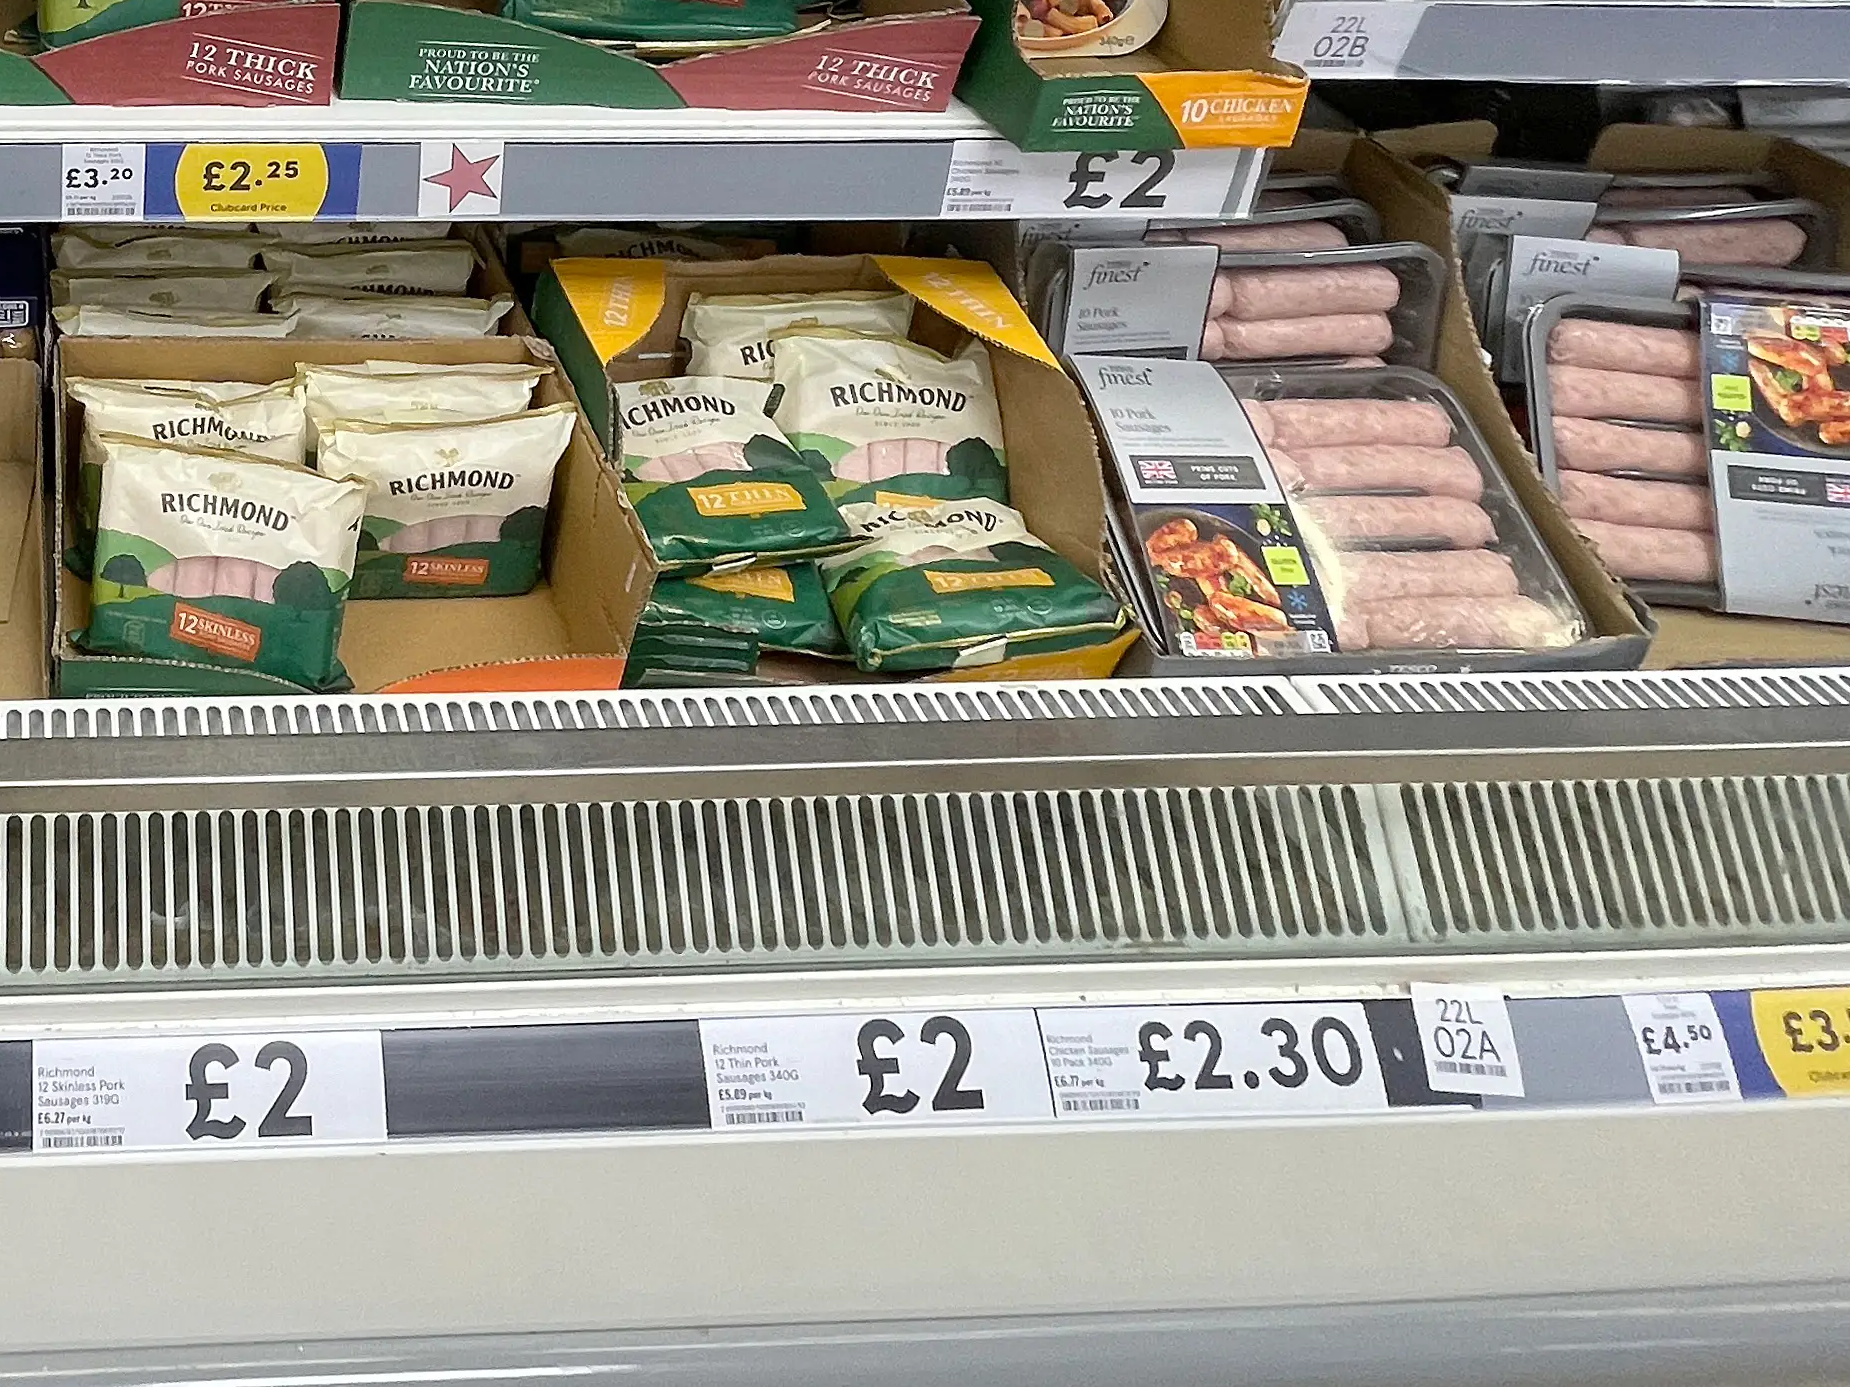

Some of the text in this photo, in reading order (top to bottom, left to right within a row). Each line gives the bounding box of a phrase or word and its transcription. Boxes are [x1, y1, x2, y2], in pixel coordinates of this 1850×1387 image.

[1331, 17, 1365, 33] 22L
[419, 48, 540, 62] PROUD TO BE THE
[1313, 36, 1366, 57] 02B
[190, 43, 318, 80] 12 THICK
[423, 60, 529, 76] NATION'S
[815, 54, 935, 89] 12 THICK
[186, 61, 314, 94] PORK SAUSAGES
[807, 72, 931, 102] PORK SAUSAGES
[1181, 100, 1292, 123] 10 CHICKEN
[66, 167, 133, 189] £3.20
[203, 160, 298, 191] £2.25
[1064, 151, 1175, 208] £2
[210, 203, 287, 212] Clubcard Price
[389, 471, 514, 496] RICHMOND
[697, 487, 789, 509] 12 THIN
[161, 492, 289, 532] RICHMOND
[409, 561, 485, 575] 12 SKINLESS
[178, 613, 256, 647] 12 SKINLESS
[1436, 999, 1482, 1025] 22L
[713, 1043, 768, 1054] Richmond
[1434, 1026, 1501, 1061] 02A
[1641, 1026, 1712, 1055] £4.50
[715, 1056, 779, 1069] 12 Thin Pork
[857, 1016, 984, 1114] £2
[1138, 1016, 1363, 1091] £2.30
[38, 1066, 95, 1078] Richmond
[717, 1070, 799, 1085] Sausages 340G
[38, 1080, 124, 1091] 12 Skinless Pork
[186, 1040, 312, 1140] £2
